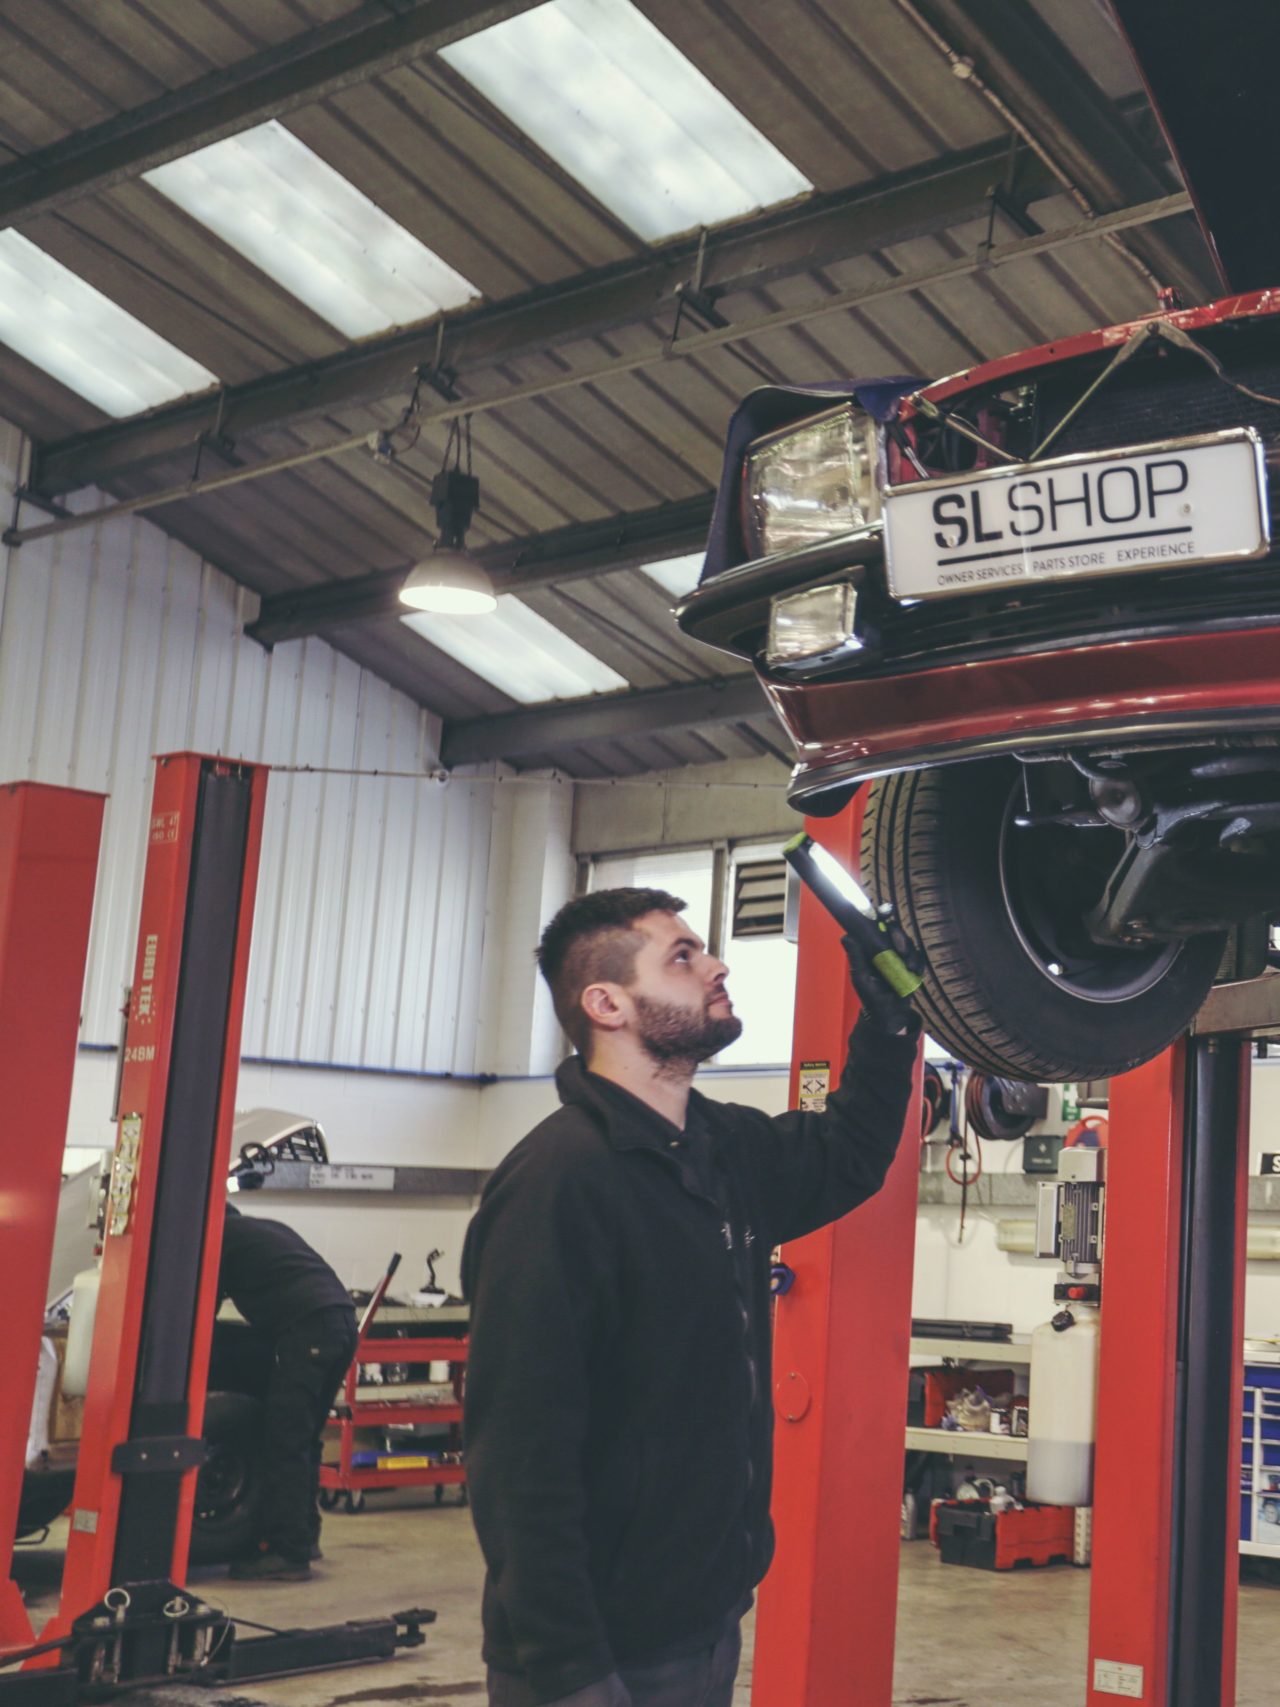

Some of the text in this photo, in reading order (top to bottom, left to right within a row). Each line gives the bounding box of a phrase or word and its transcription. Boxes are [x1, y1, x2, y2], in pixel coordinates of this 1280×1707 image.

[932, 459, 1189, 548] SLSHOP
[937, 541, 1195, 586] OWNER SERVICES PARTS STORE EXPERIENCE
[139, 934, 158, 1014] EURO TEK
